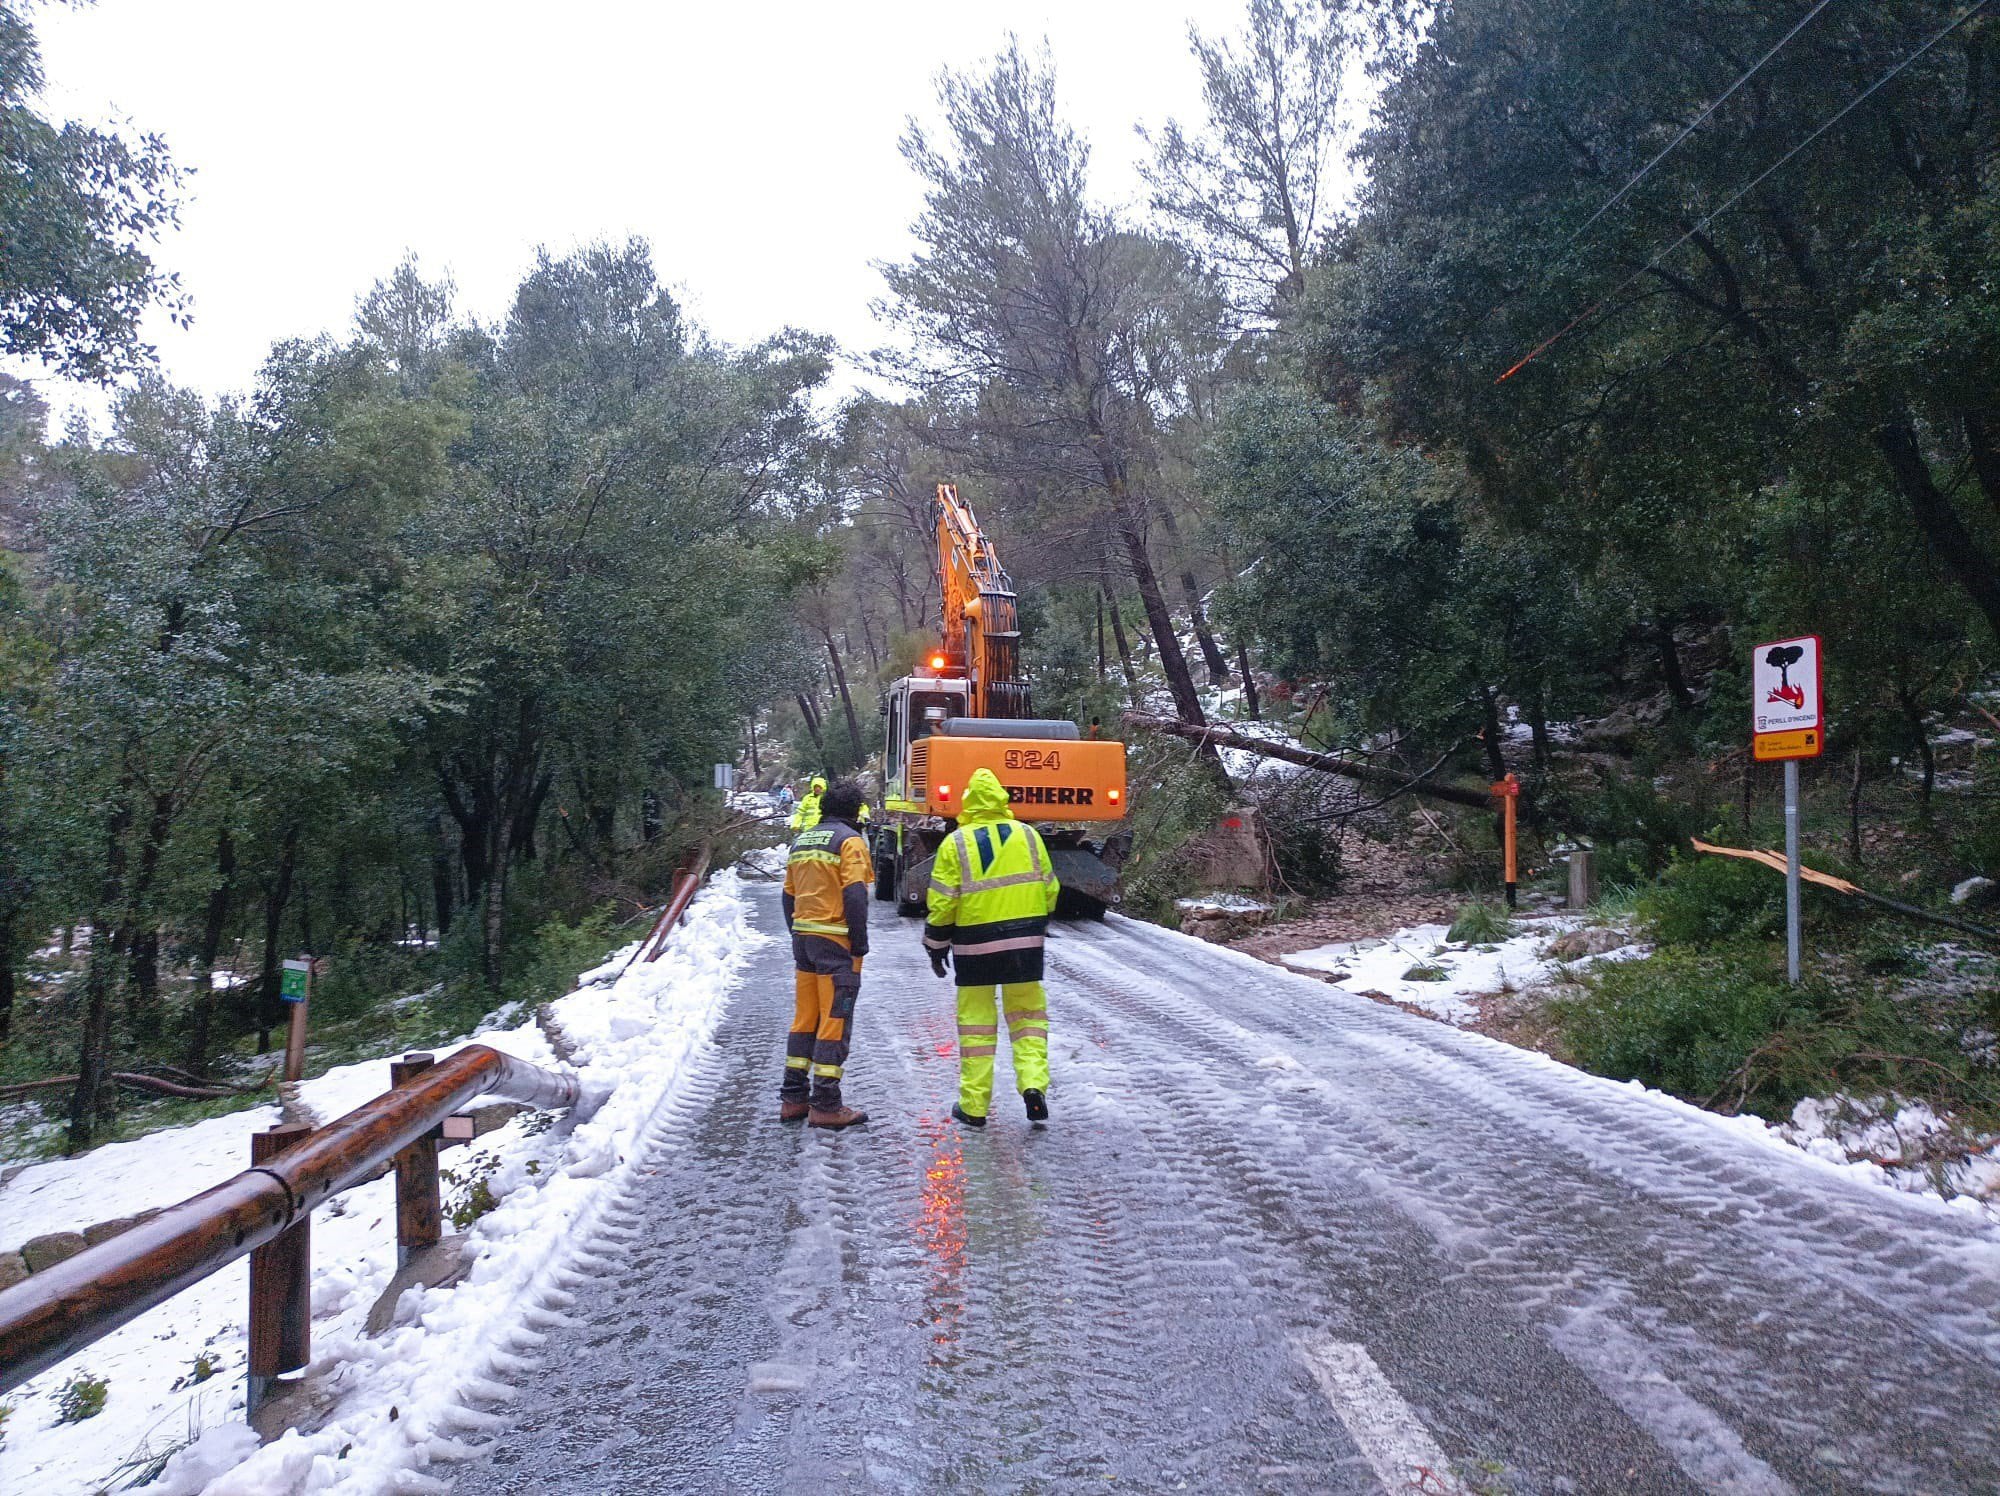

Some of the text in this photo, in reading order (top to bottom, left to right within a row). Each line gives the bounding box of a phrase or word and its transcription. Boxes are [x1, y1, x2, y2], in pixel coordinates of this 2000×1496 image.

[1767, 717, 1787, 725] PERILL
[1005, 749, 1060, 770] 924
[1002, 786, 1094, 805] BHERR
